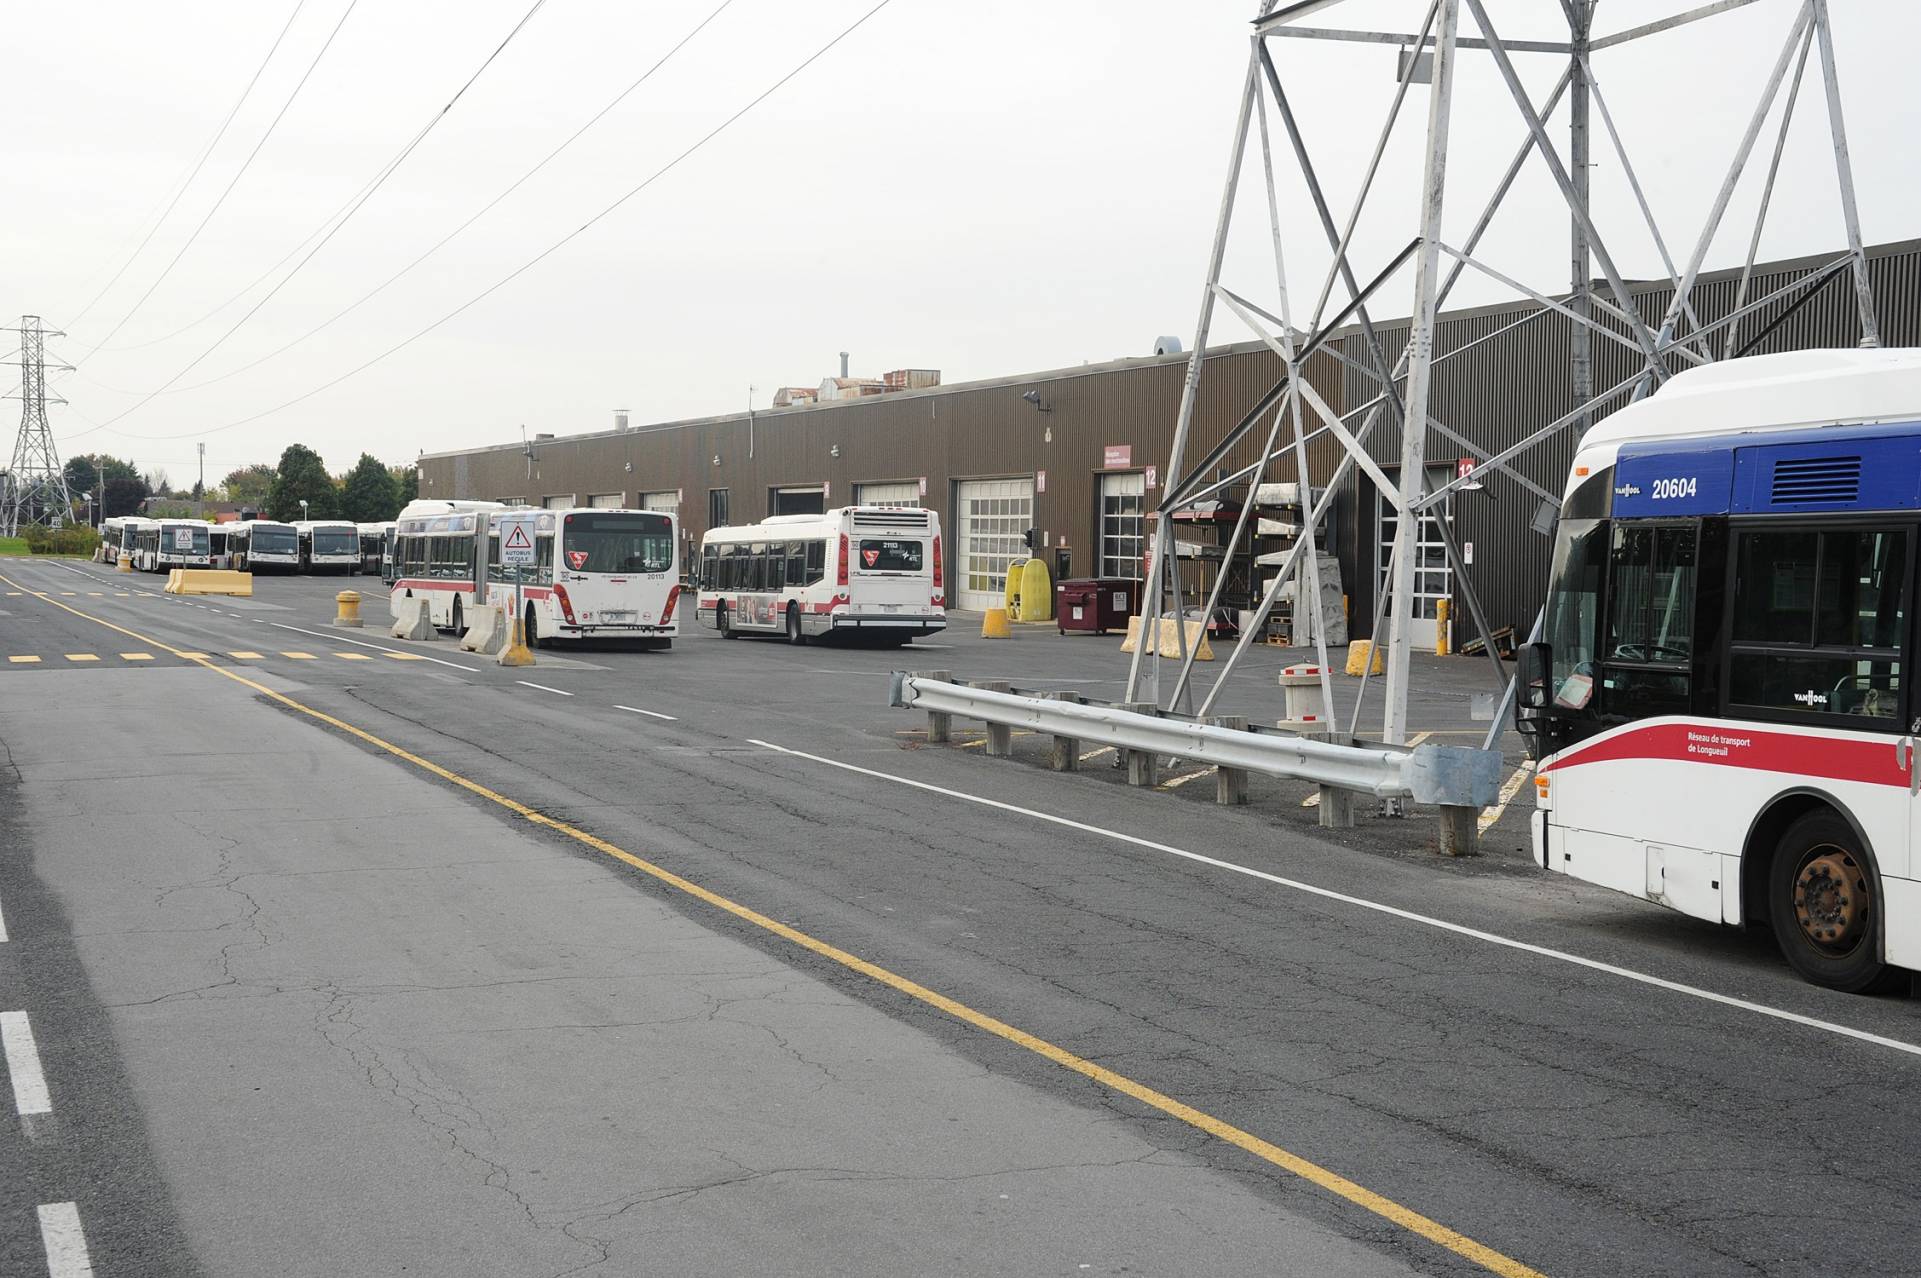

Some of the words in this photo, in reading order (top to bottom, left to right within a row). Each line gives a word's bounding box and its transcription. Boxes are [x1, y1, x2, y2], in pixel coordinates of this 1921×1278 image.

[1037, 474, 1045, 489] 11
[1145, 469, 1156, 486] 12
[1651, 477, 1697, 499] 20604
[1687, 731, 1710, 743] Réseau
[1711, 734, 1720, 744] de
[1720, 736, 1751, 748] transport
[1687, 743, 1697, 753] de
[1697, 744, 1729, 757] Longueuil
